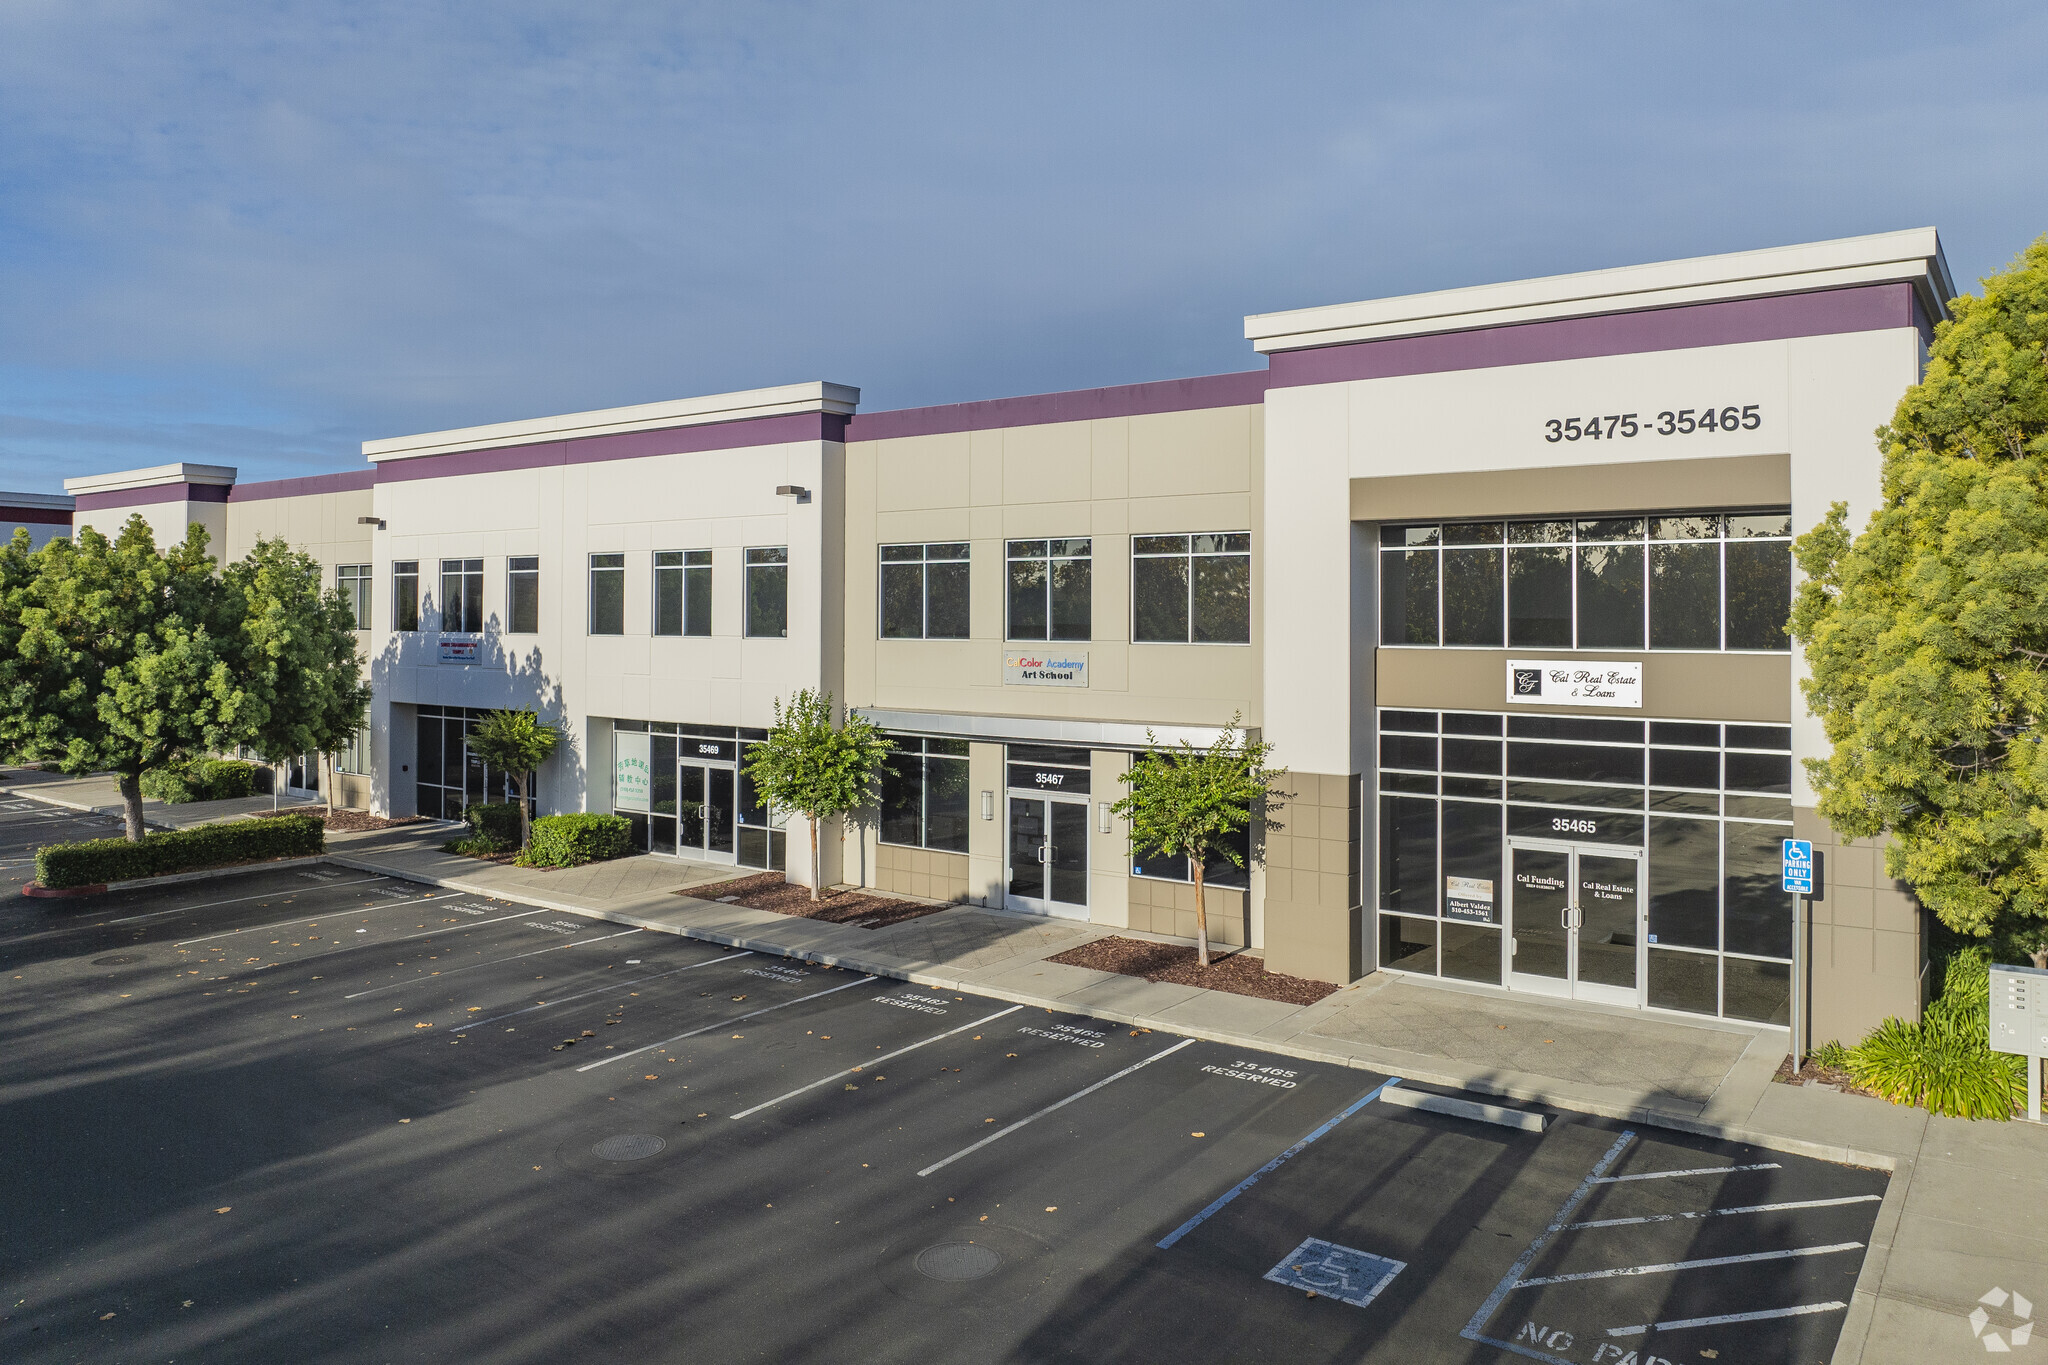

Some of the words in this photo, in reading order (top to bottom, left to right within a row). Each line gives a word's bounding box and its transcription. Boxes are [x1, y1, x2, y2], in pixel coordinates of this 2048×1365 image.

[1046, 658, 1084, 671] Academy
[1022, 670, 1037, 679] Art
[1039, 671, 1073, 680] School
[1549, 670, 1569, 683] Cal
[1573, 671, 1603, 684] Real
[1607, 671, 1637, 685] Estate
[1571, 688, 1579, 697] &
[1583, 684, 1616, 698] Loans
[698, 744, 719, 754] 35469
[1035, 773, 1064, 785] 35467
[1552, 818, 1596, 833] 35465
[1785, 859, 1811, 869] PARKING
[1788, 868, 1807, 877] ONLY
[1516, 874, 1530, 883] Cal
[1531, 875, 1565, 888] Funding
[1582, 881, 1594, 890] Cal
[1595, 882, 1611, 891] Real
[1612, 884, 1634, 894] Estate
[1601, 891, 1622, 900] Loans
[1450, 900, 1469, 908] Albert
[1470, 902, 1491, 910] Valdez
[871, 995, 947, 1015] RESERVED
[1017, 1026, 1105, 1048] RESERVED
[1230, 1060, 1298, 1078] 35465
[1201, 1064, 1297, 1089] RESERVED
[1516, 1321, 1574, 1351] NO
